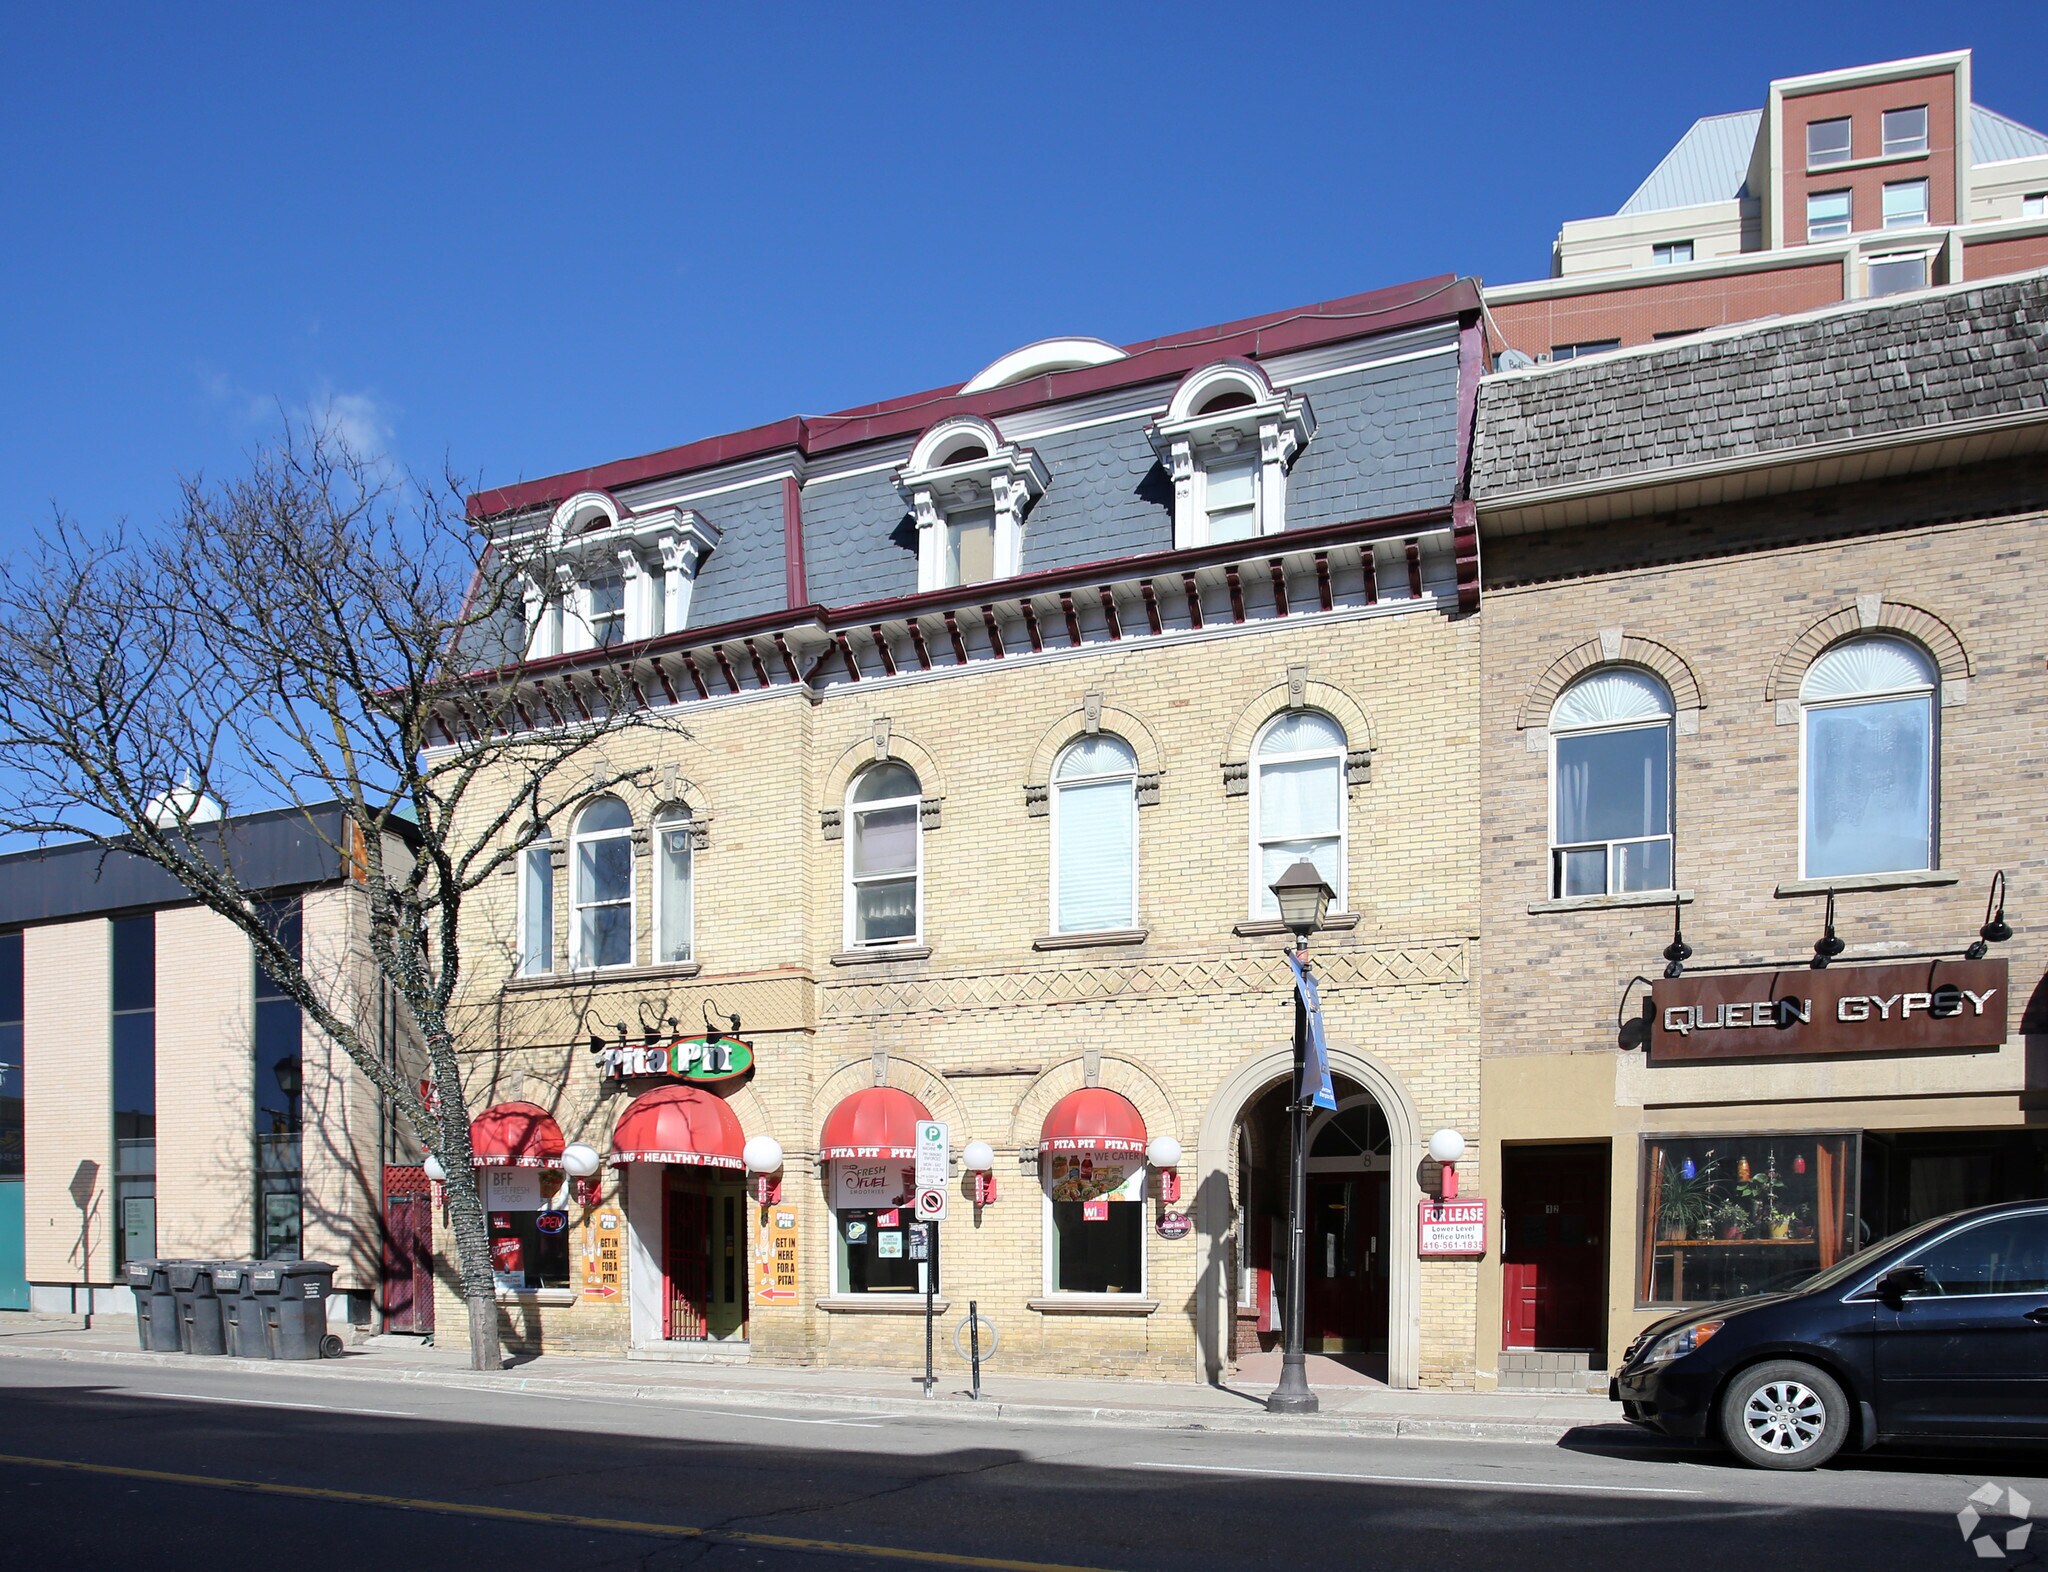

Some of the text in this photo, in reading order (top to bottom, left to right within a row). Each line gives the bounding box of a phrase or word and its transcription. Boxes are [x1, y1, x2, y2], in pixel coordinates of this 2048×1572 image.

[1664, 988, 1997, 1035] QUEEN GYPSY
[605, 1042, 732, 1077] Pita Pit
[1053, 1139, 1076, 1149] PITA
[1077, 1139, 1097, 1149] PIT
[1104, 1140, 1129, 1150] PITA
[1130, 1141, 1143, 1152] PIT
[830, 1148, 856, 1158] PITA
[857, 1147, 880, 1158] PIT
[1094, 1152, 1139, 1160] WE CATER
[486, 1157, 506, 1166] PIT
[515, 1158, 545, 1167] PITA
[644, 1153, 701, 1165] HEALTHY
[703, 1156, 742, 1169] EATING
[1364, 1154, 1371, 1167] 8
[857, 1165, 886, 1177] FRESH
[493, 1173, 513, 1186] BFF
[859, 1176, 890, 1188] FUEL
[1424, 1207, 1483, 1222] FOR LEASE
[539, 1216, 563, 1228] OPEN
[600, 1238, 618, 1247] GET IN
[775, 1238, 795, 1248] GET IN
[1423, 1241, 1483, 1249] 416-561-1835
[602, 1250, 617, 1259] HERE
[777, 1251, 793, 1260] HERE
[602, 1261, 618, 1271] FOR A
[776, 1263, 795, 1273] FOR A
[602, 1274, 617, 1283] PITA!
[777, 1276, 794, 1285] PITA!
